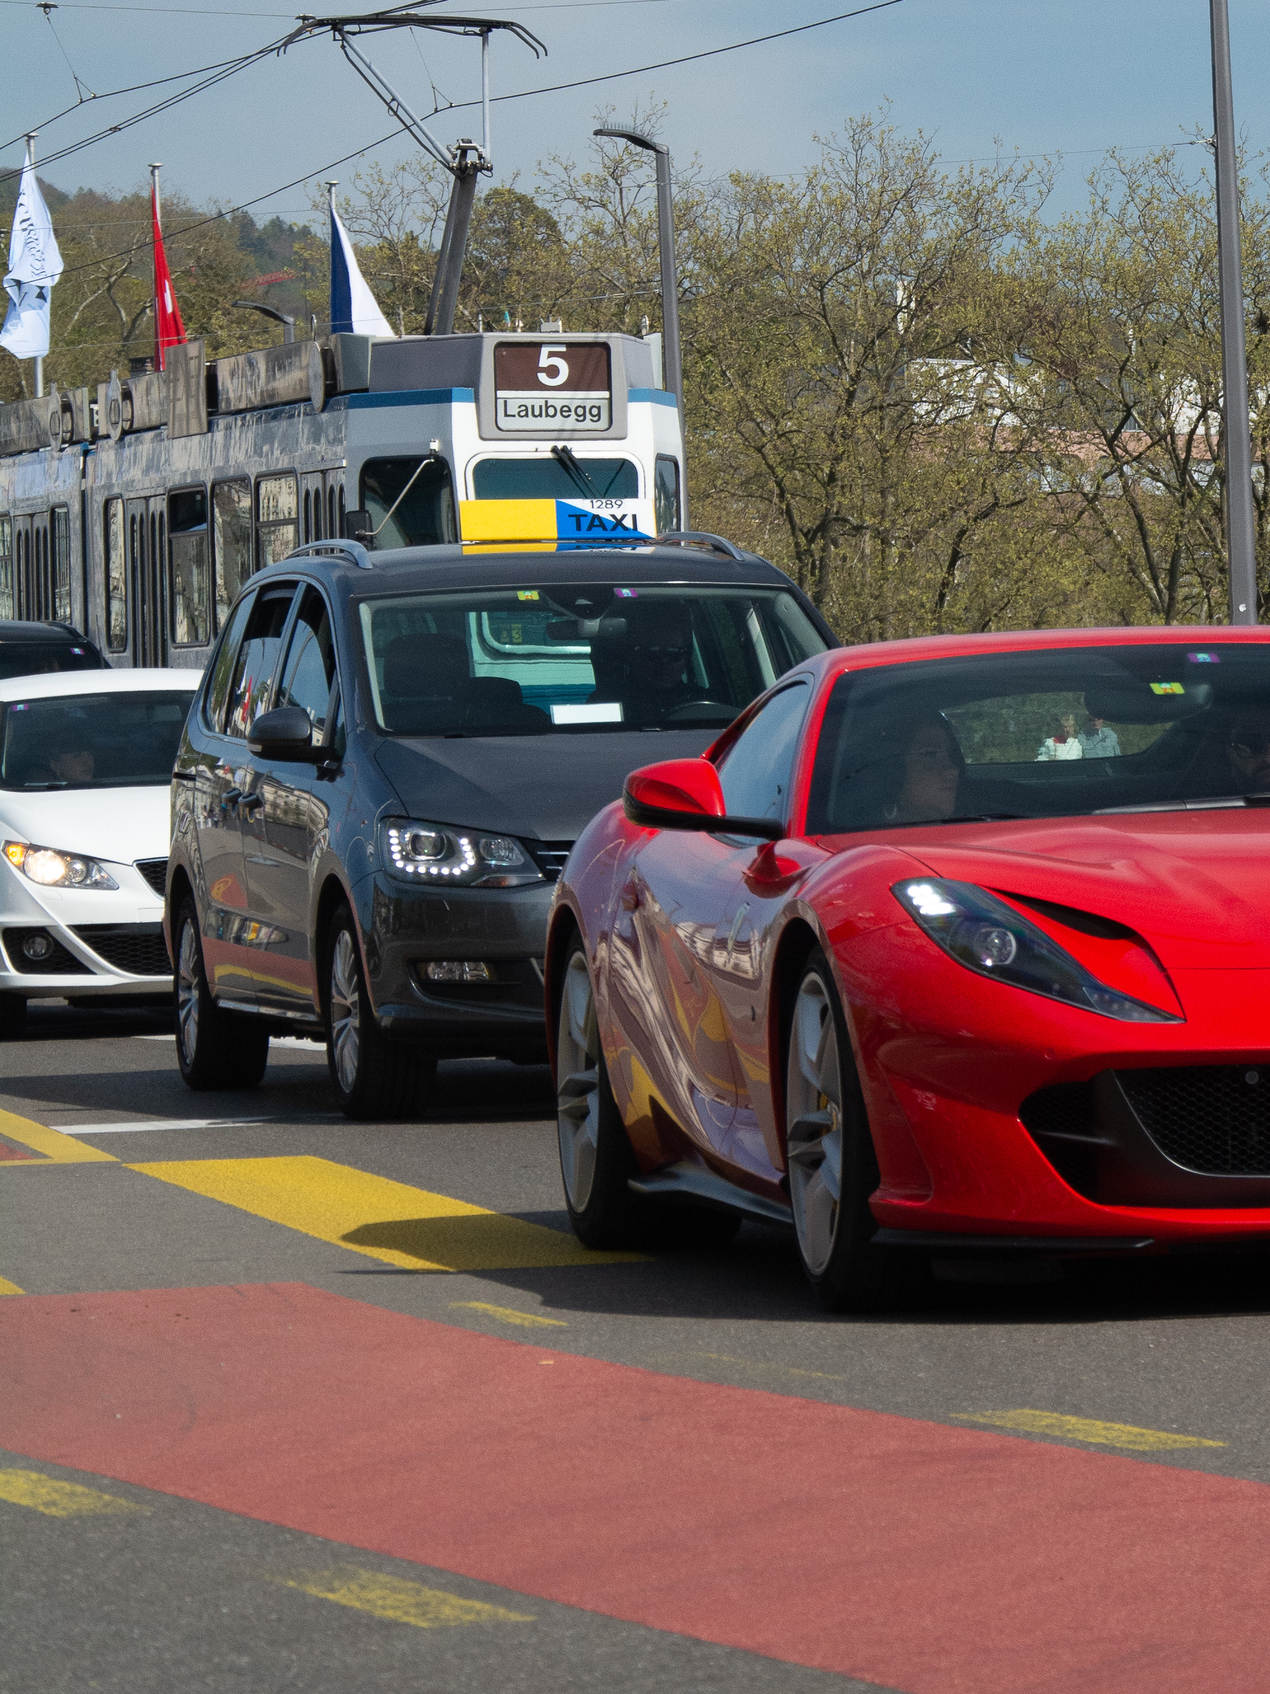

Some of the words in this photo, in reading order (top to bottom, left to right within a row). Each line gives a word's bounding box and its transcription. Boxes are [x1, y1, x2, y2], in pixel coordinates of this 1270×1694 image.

[537, 344, 569, 387] 5
[503, 400, 602, 423] Laubegg
[590, 499, 623, 509] 1289
[568, 513, 638, 532] TAXI
